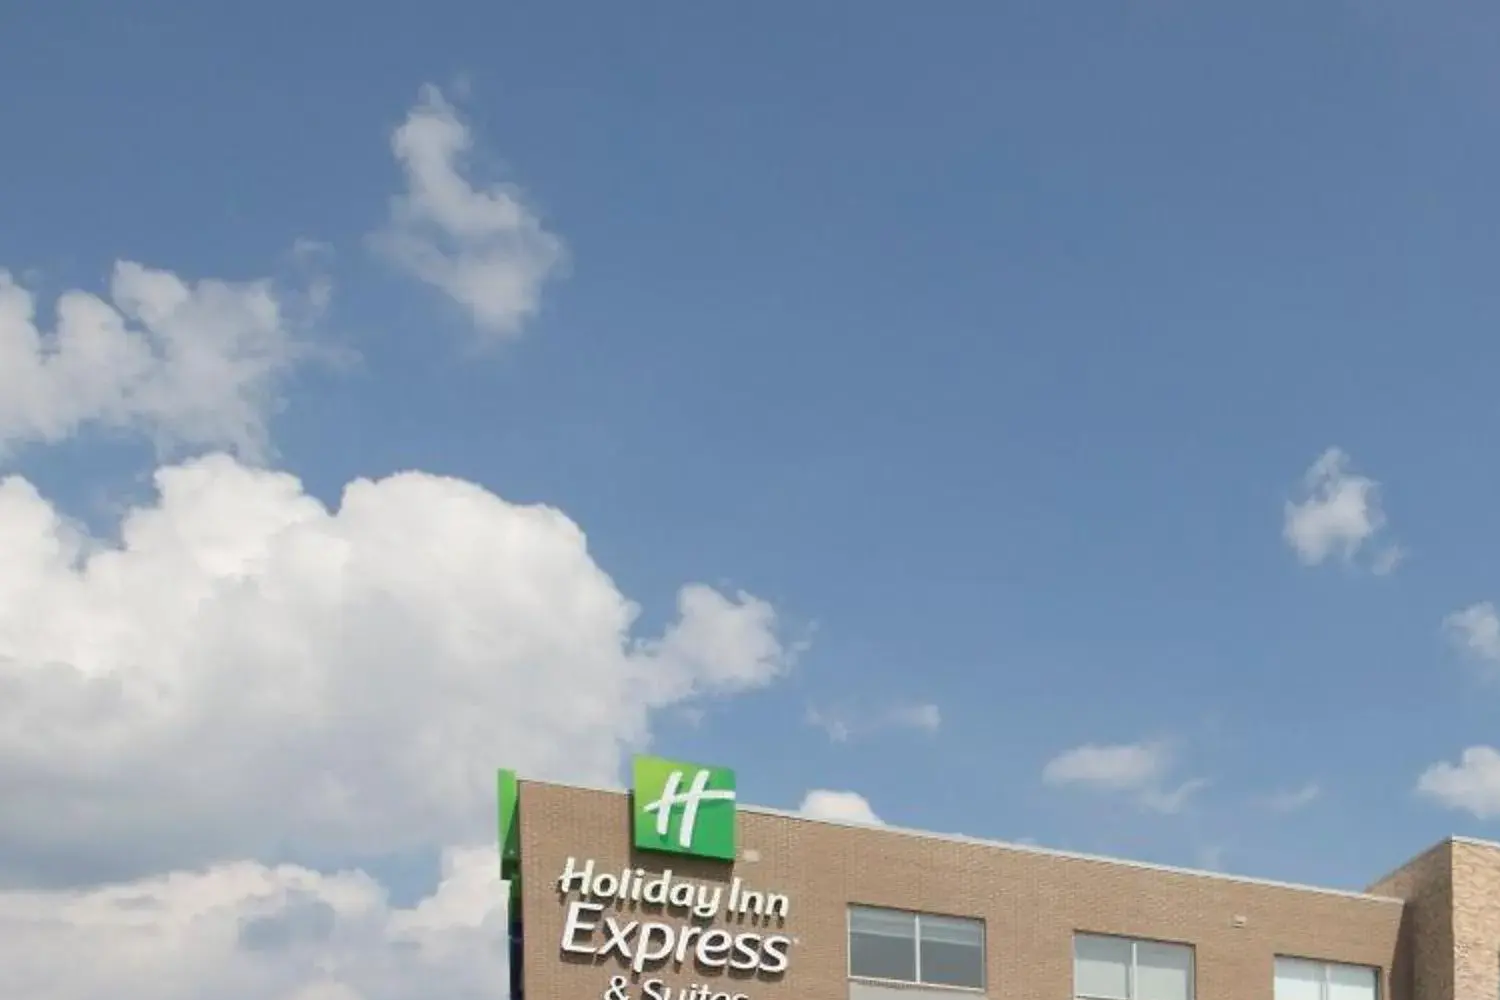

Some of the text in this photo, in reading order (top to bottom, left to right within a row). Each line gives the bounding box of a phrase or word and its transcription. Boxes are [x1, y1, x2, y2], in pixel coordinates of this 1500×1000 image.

[644, 769, 735, 848] H
[559, 857, 789, 917] Holiday Inn
[562, 902, 791, 973] Express
